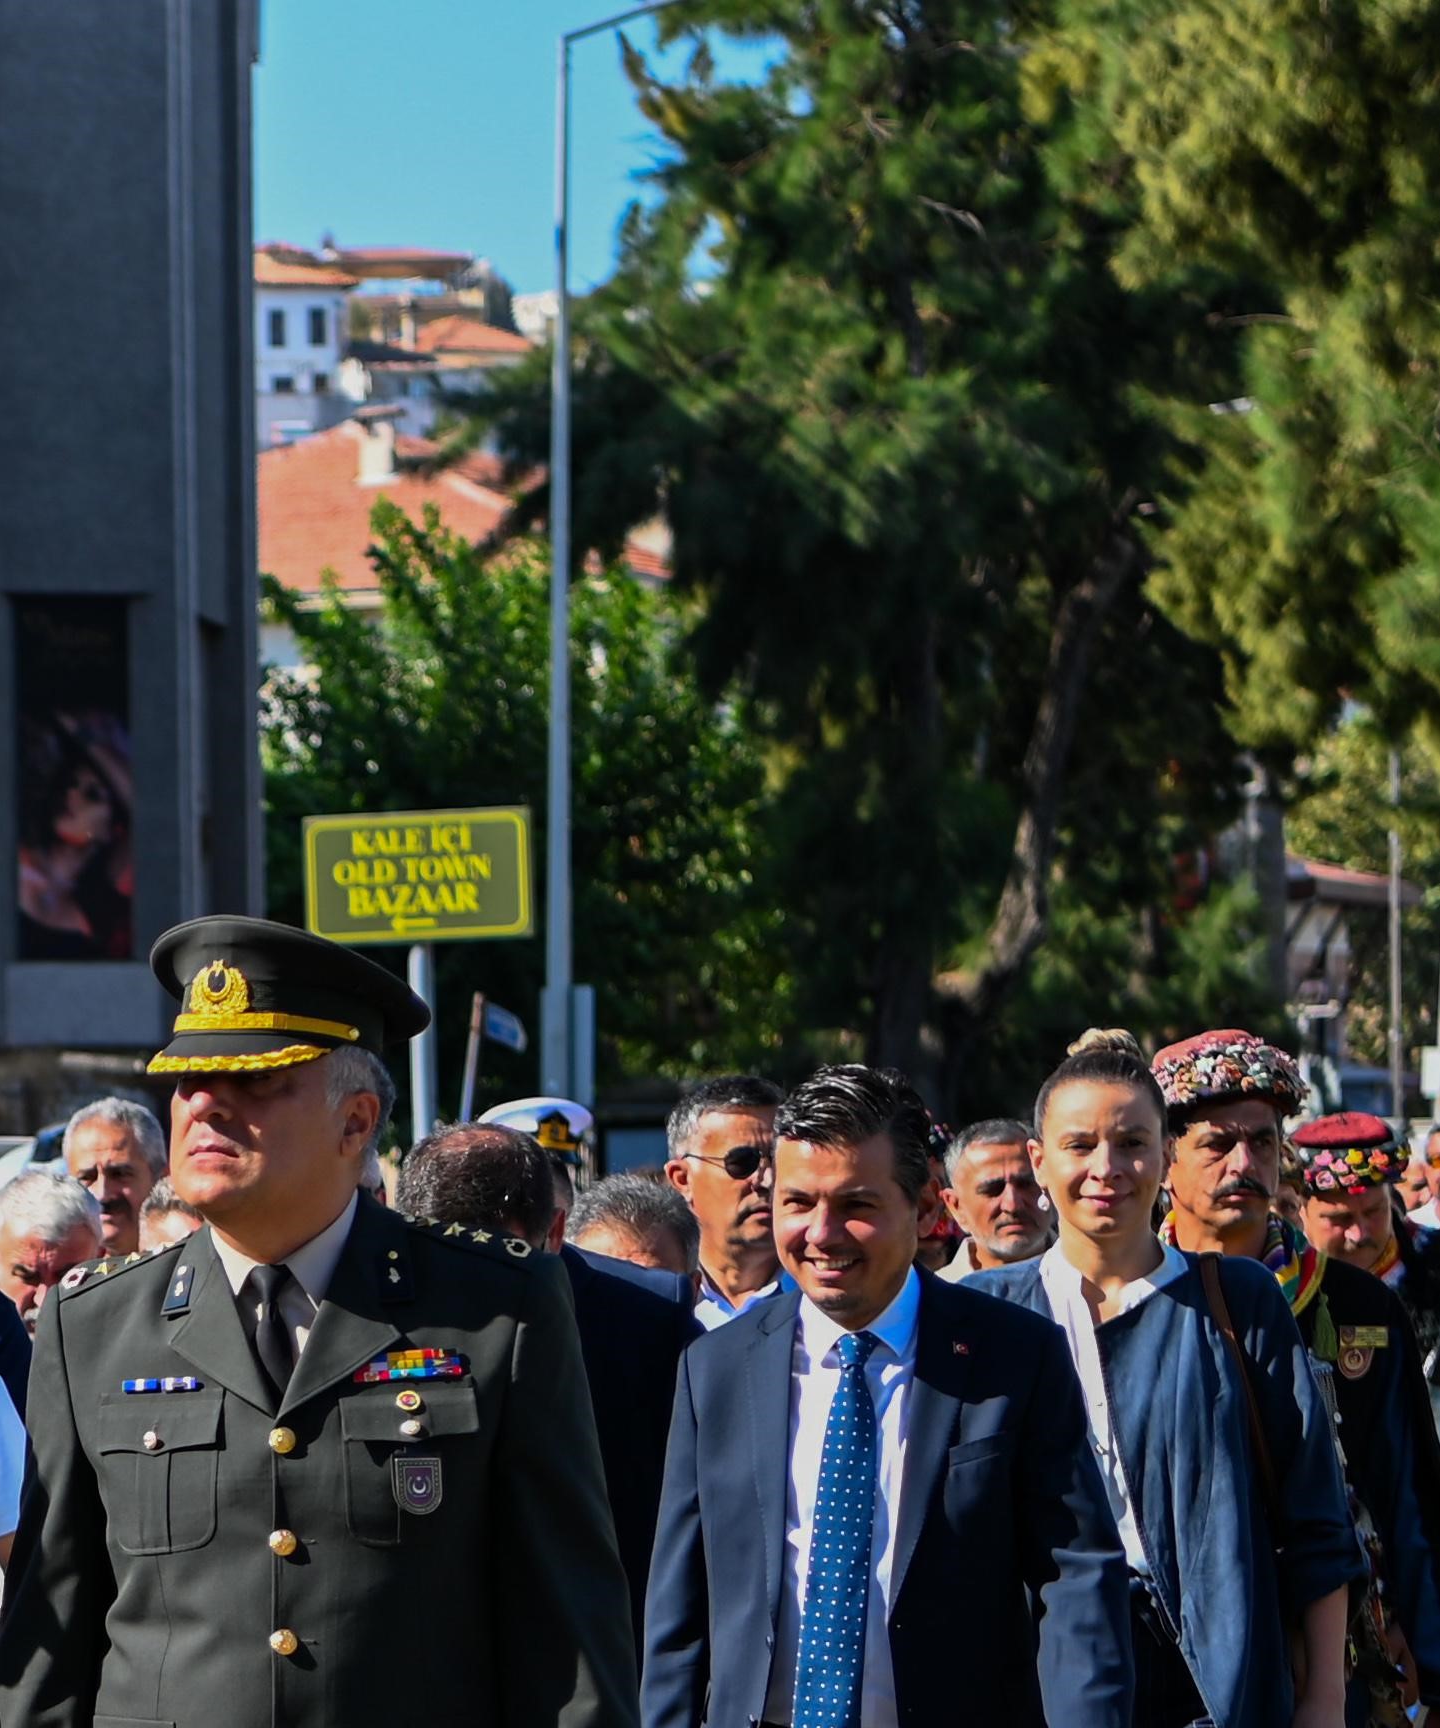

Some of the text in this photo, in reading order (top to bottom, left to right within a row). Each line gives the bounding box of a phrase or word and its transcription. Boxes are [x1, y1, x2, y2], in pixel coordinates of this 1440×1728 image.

[351, 827, 425, 856] KALE
[332, 853, 492, 886] OLD TOWN
[348, 881, 480, 918] BAZAAR
